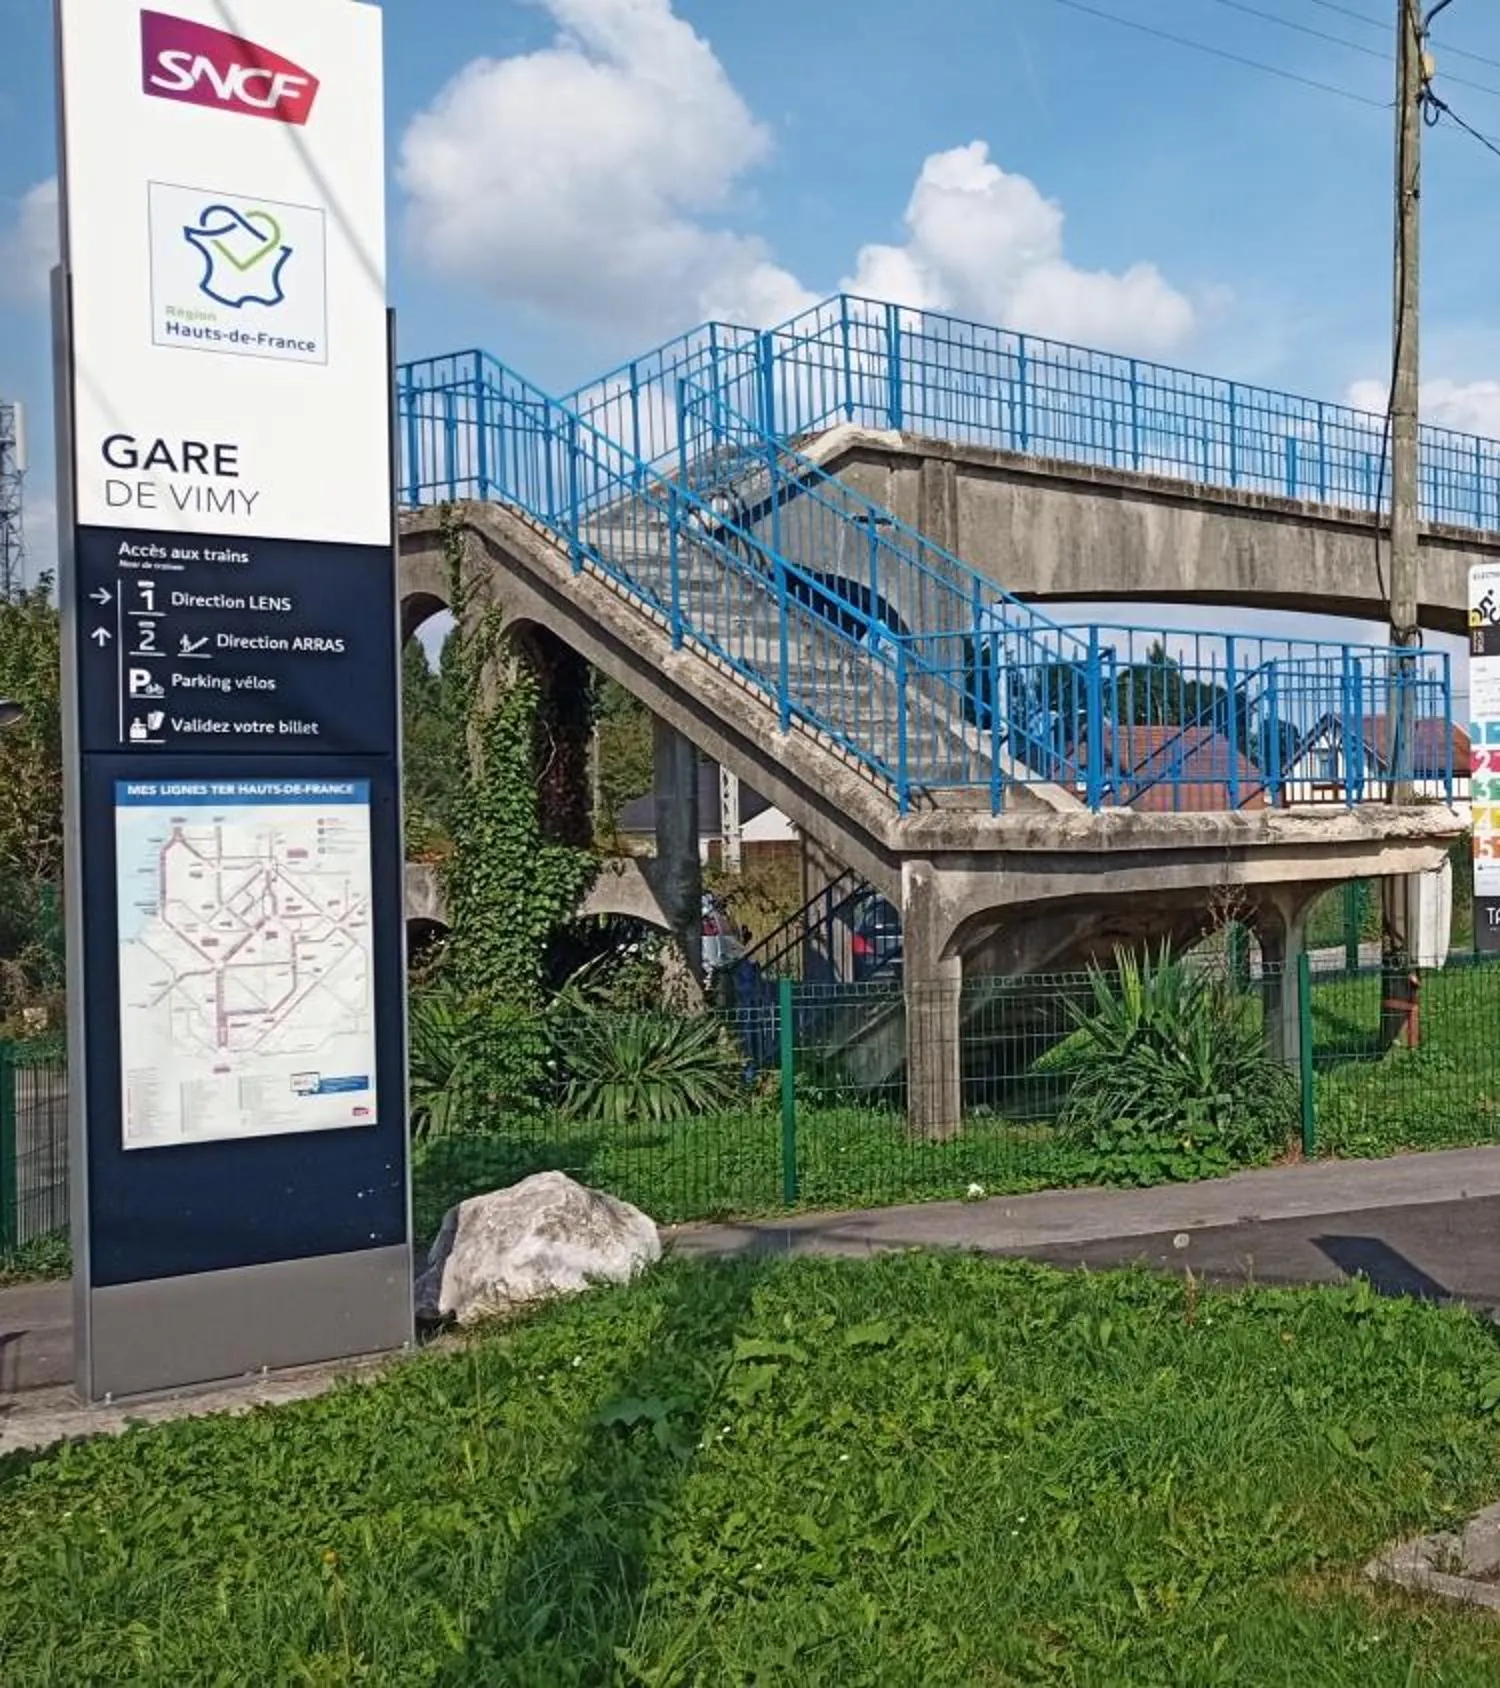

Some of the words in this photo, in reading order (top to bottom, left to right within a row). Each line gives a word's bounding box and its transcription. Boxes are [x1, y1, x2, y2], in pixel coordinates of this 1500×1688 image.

[150, 50, 308, 108] SNCF
[166, 321, 317, 352] Hauts-de-France
[101, 434, 240, 478] GARE
[105, 479, 156, 509] DE
[168, 484, 260, 516] VIMY
[118, 541, 167, 559] Accès
[171, 548, 199, 560] aux
[203, 549, 249, 563] trains
[139, 588, 153, 611] 1
[171, 591, 245, 609] Direction
[249, 596, 292, 612] LENS
[139, 630, 155, 650] 2
[217, 633, 288, 651] Direction
[292, 635, 345, 652] ARRAS
[171, 673, 231, 692] Parking
[235, 676, 277, 690] vélos
[171, 717, 229, 733] Validez
[233, 721, 275, 733] votre
[278, 719, 319, 735] billet
[1473, 750, 1492, 774] 2
[127, 784, 157, 796] MES
[211, 784, 236, 796] TER
[239, 783, 354, 796] HAUTS-DE-FRANCE
